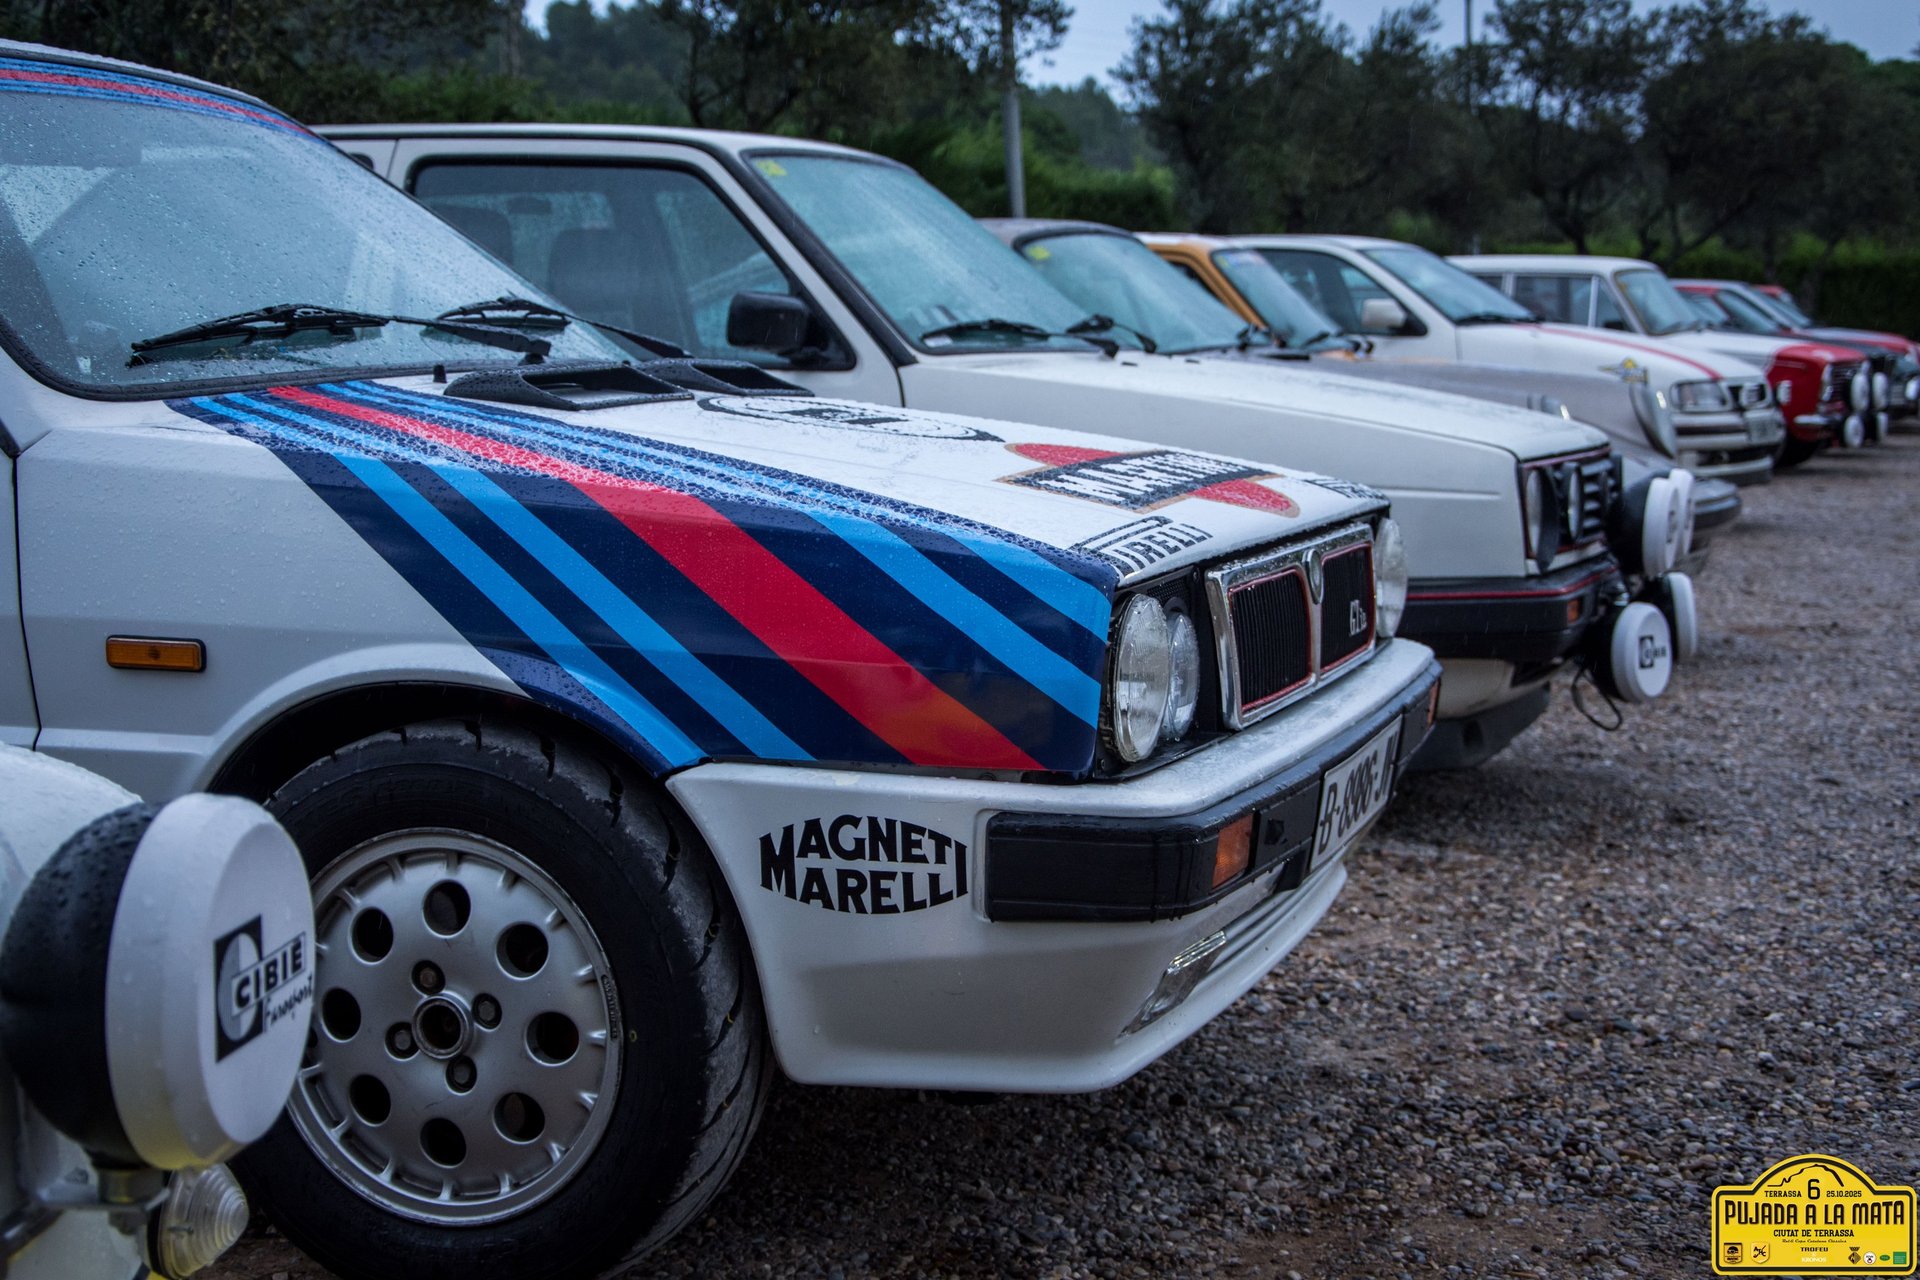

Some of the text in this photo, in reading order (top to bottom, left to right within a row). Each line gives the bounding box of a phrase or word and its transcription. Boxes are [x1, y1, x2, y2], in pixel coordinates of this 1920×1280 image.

[759, 814, 968, 865] MAGNETI
[760, 866, 968, 915] MARELLI
[235, 940, 302, 1009] CIBIE
